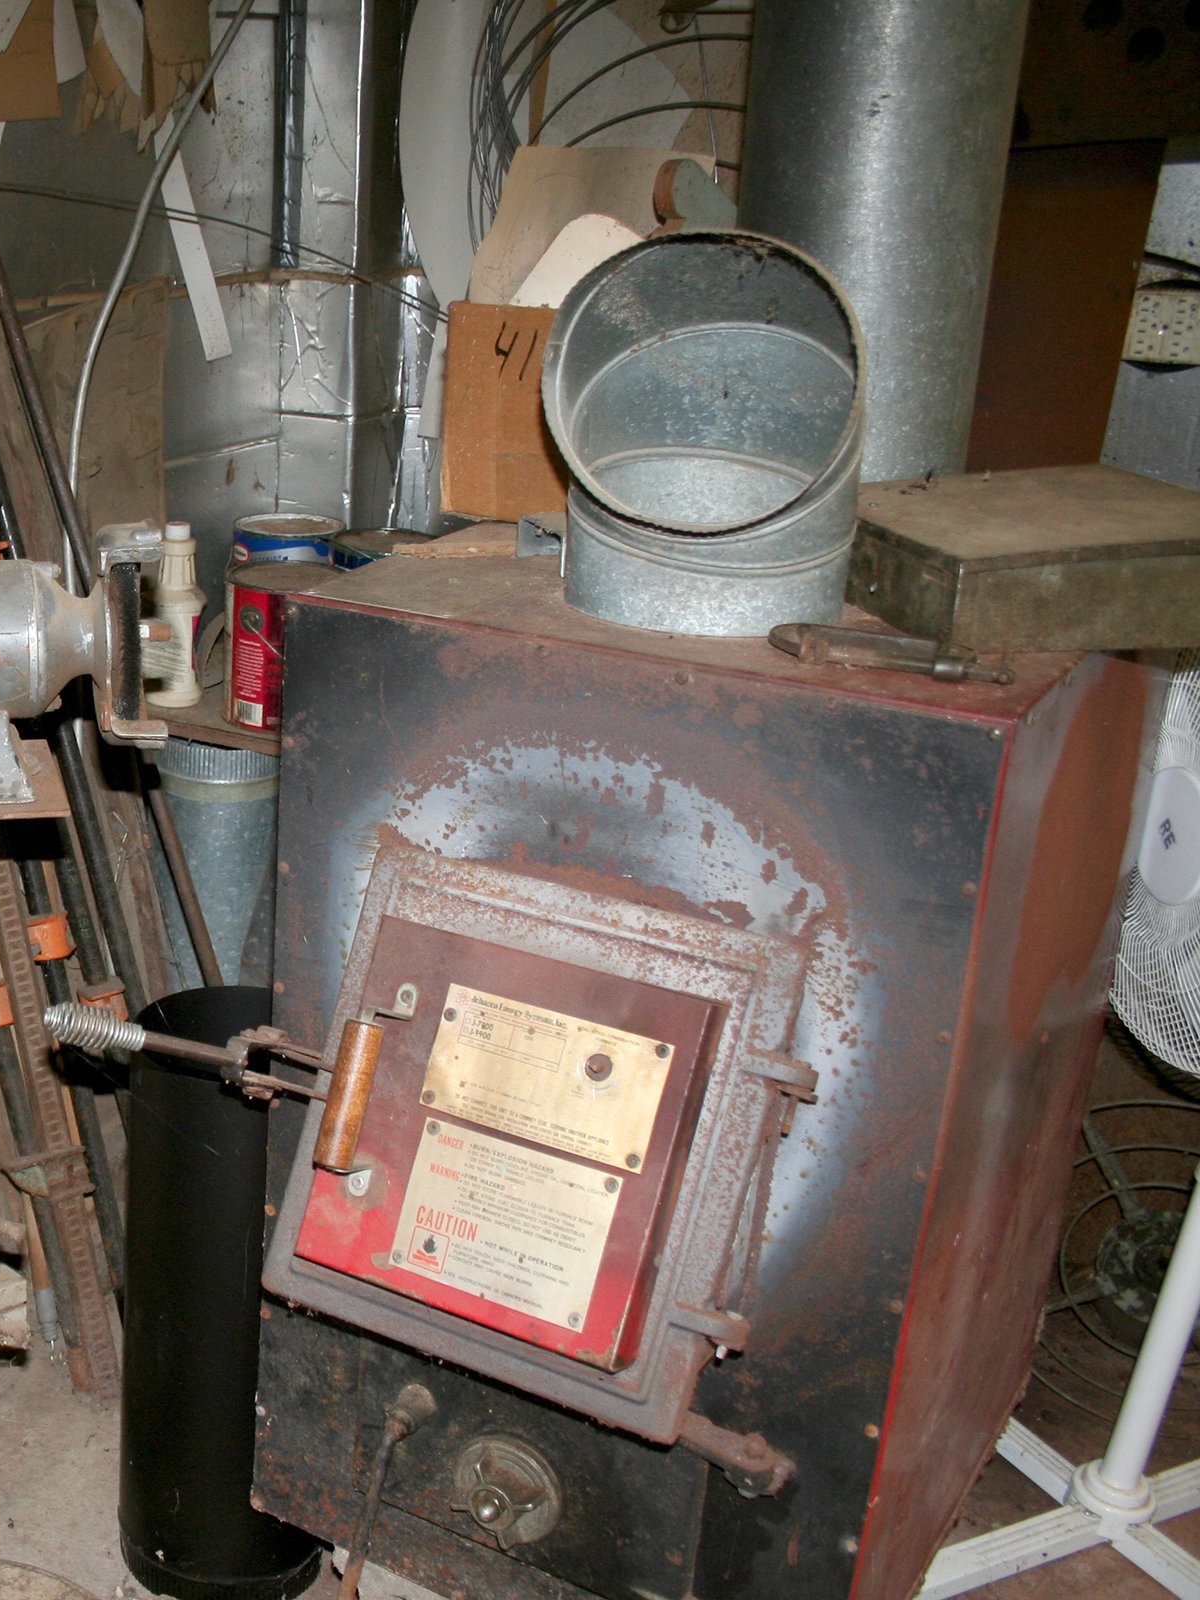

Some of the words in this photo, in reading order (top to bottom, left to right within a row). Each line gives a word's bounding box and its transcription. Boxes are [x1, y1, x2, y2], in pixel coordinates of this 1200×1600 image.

[495, 321, 538, 381] 41
[437, 1133, 465, 1152] DANGER
[428, 1162, 462, 1183] WARNING
[528, 1161, 555, 1175] HAZARD
[464, 1173, 478, 1183] FIRE
[479, 1178, 506, 1192] HAZARD
[415, 1204, 479, 1243] CAUTION
[484, 1240, 497, 1250] HOT
[527, 1255, 564, 1273] OPERATION
